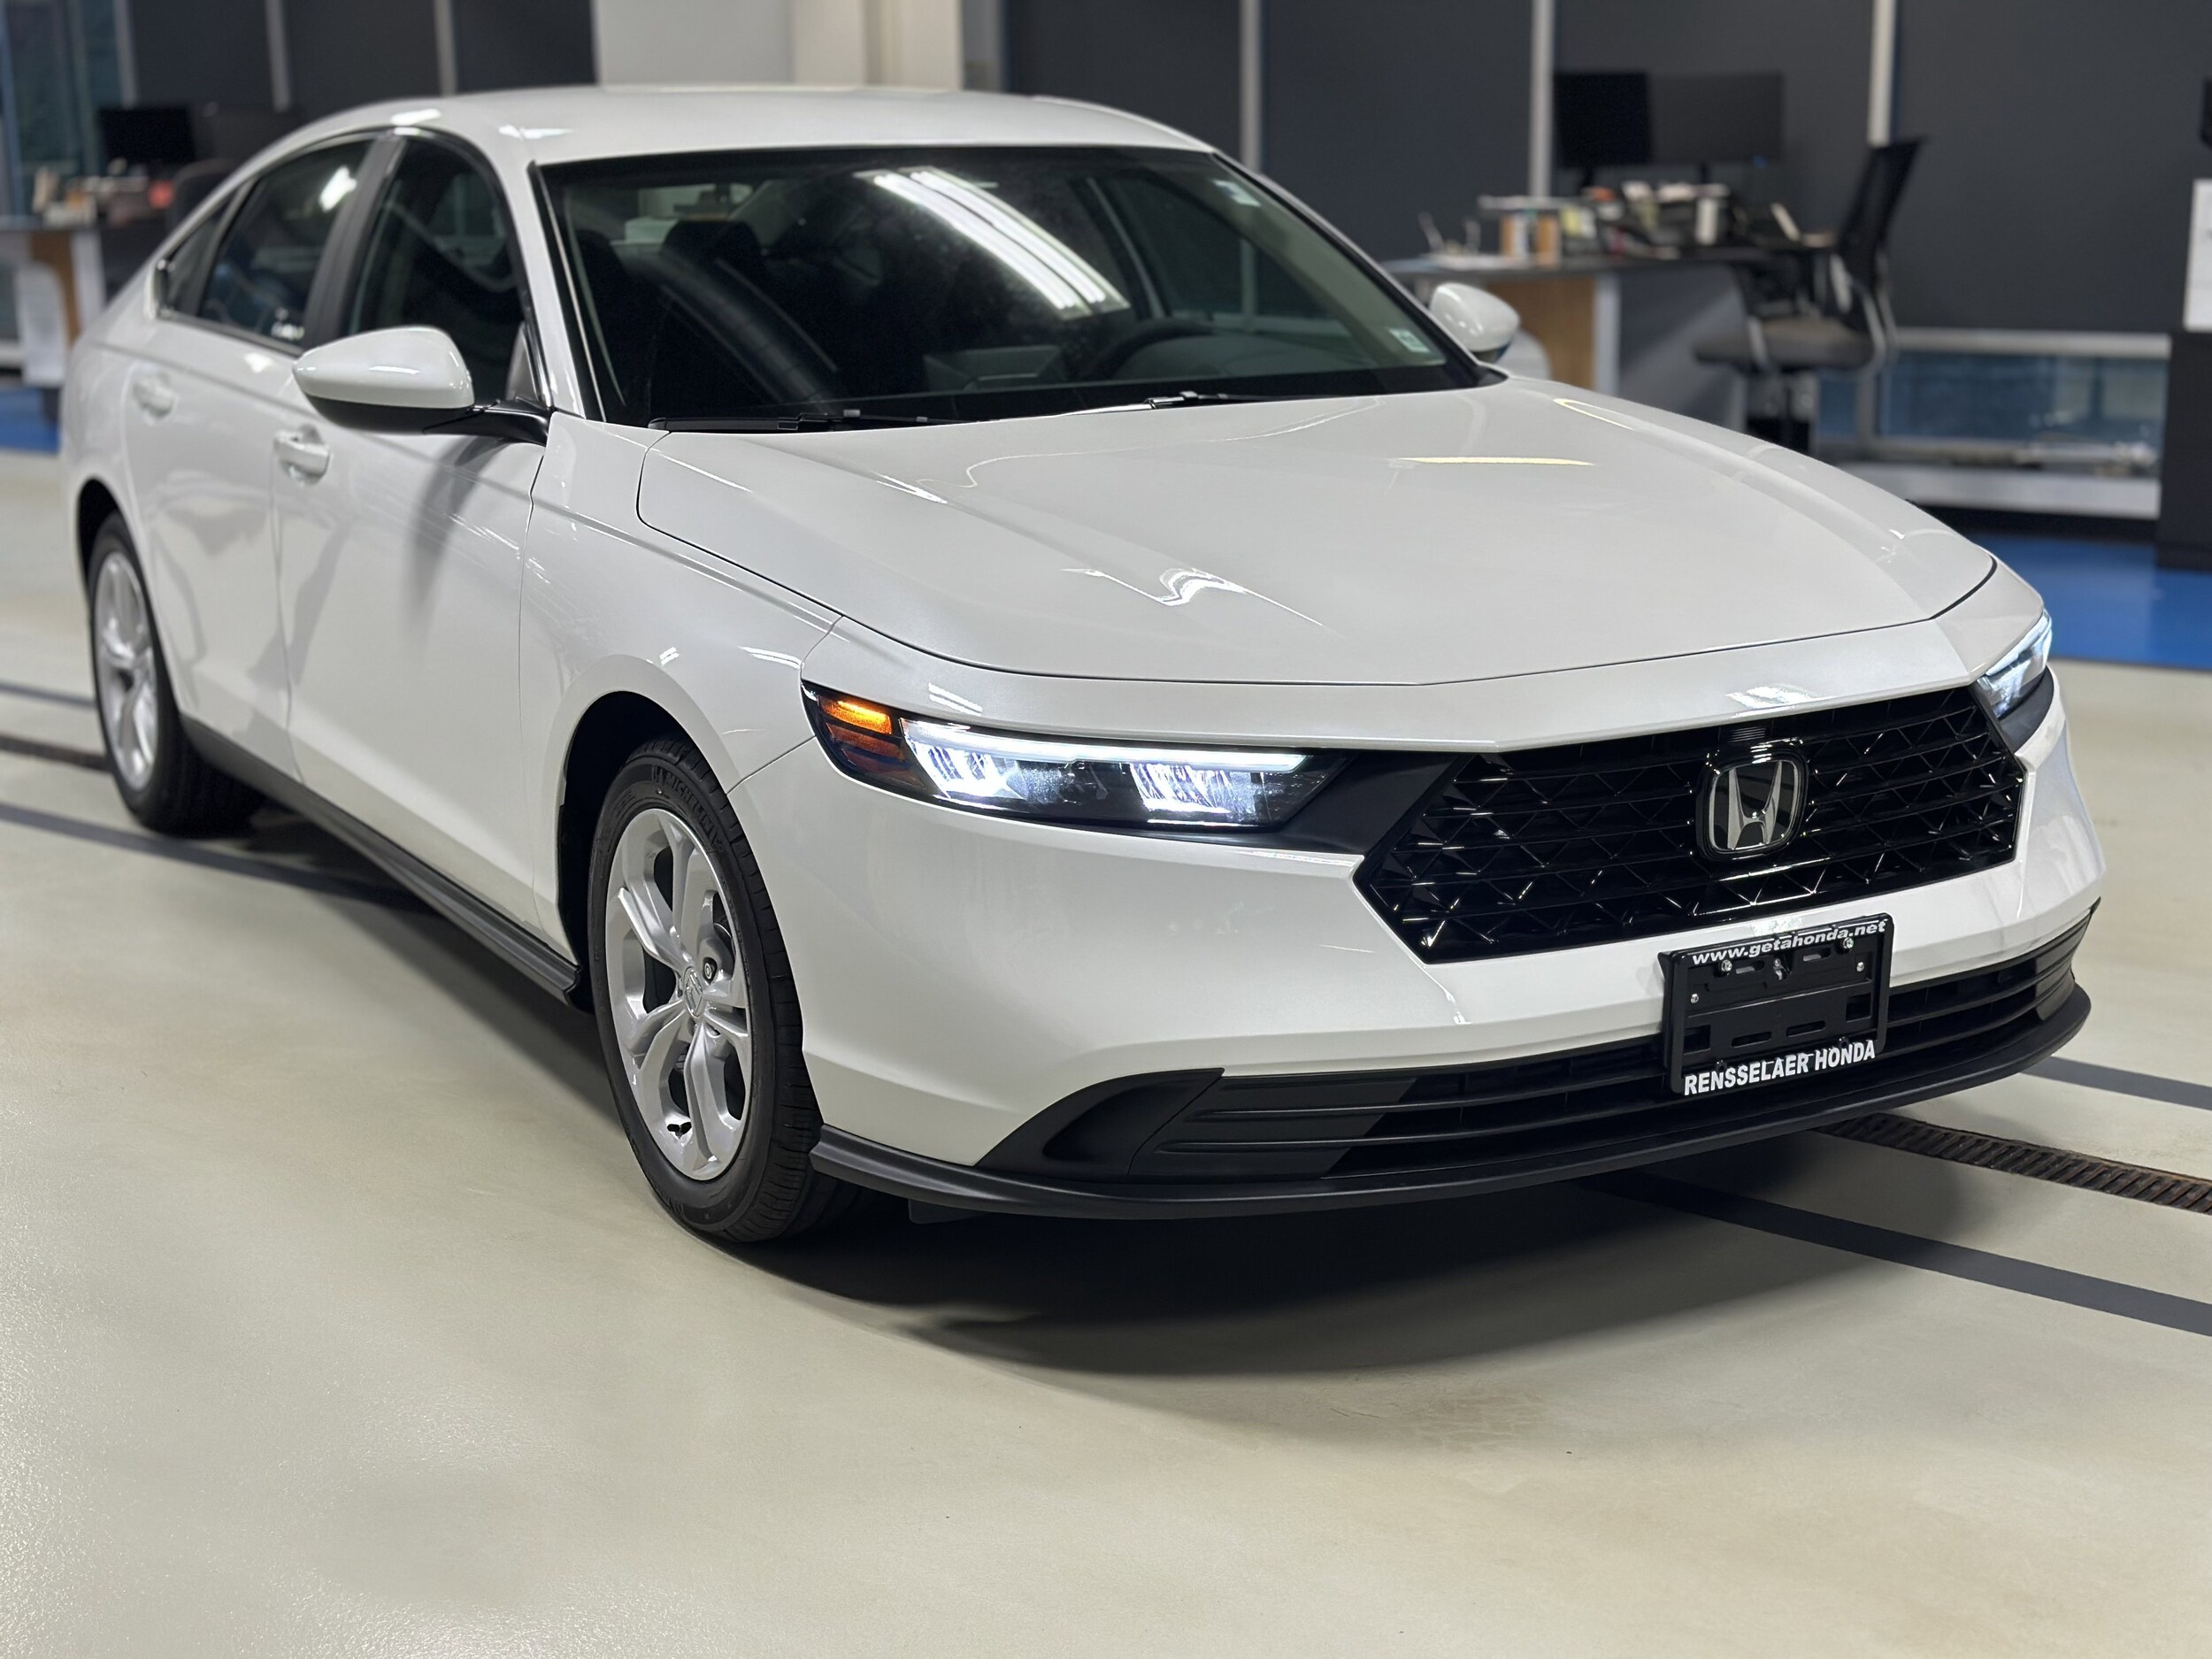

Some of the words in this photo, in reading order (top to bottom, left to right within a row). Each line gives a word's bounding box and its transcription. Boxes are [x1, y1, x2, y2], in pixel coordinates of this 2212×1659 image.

[1693, 921, 1886, 964] www.getahonda.net
[1684, 1053, 1809, 1095] RENSSELAER
[1815, 1040, 1876, 1071] HONDA
